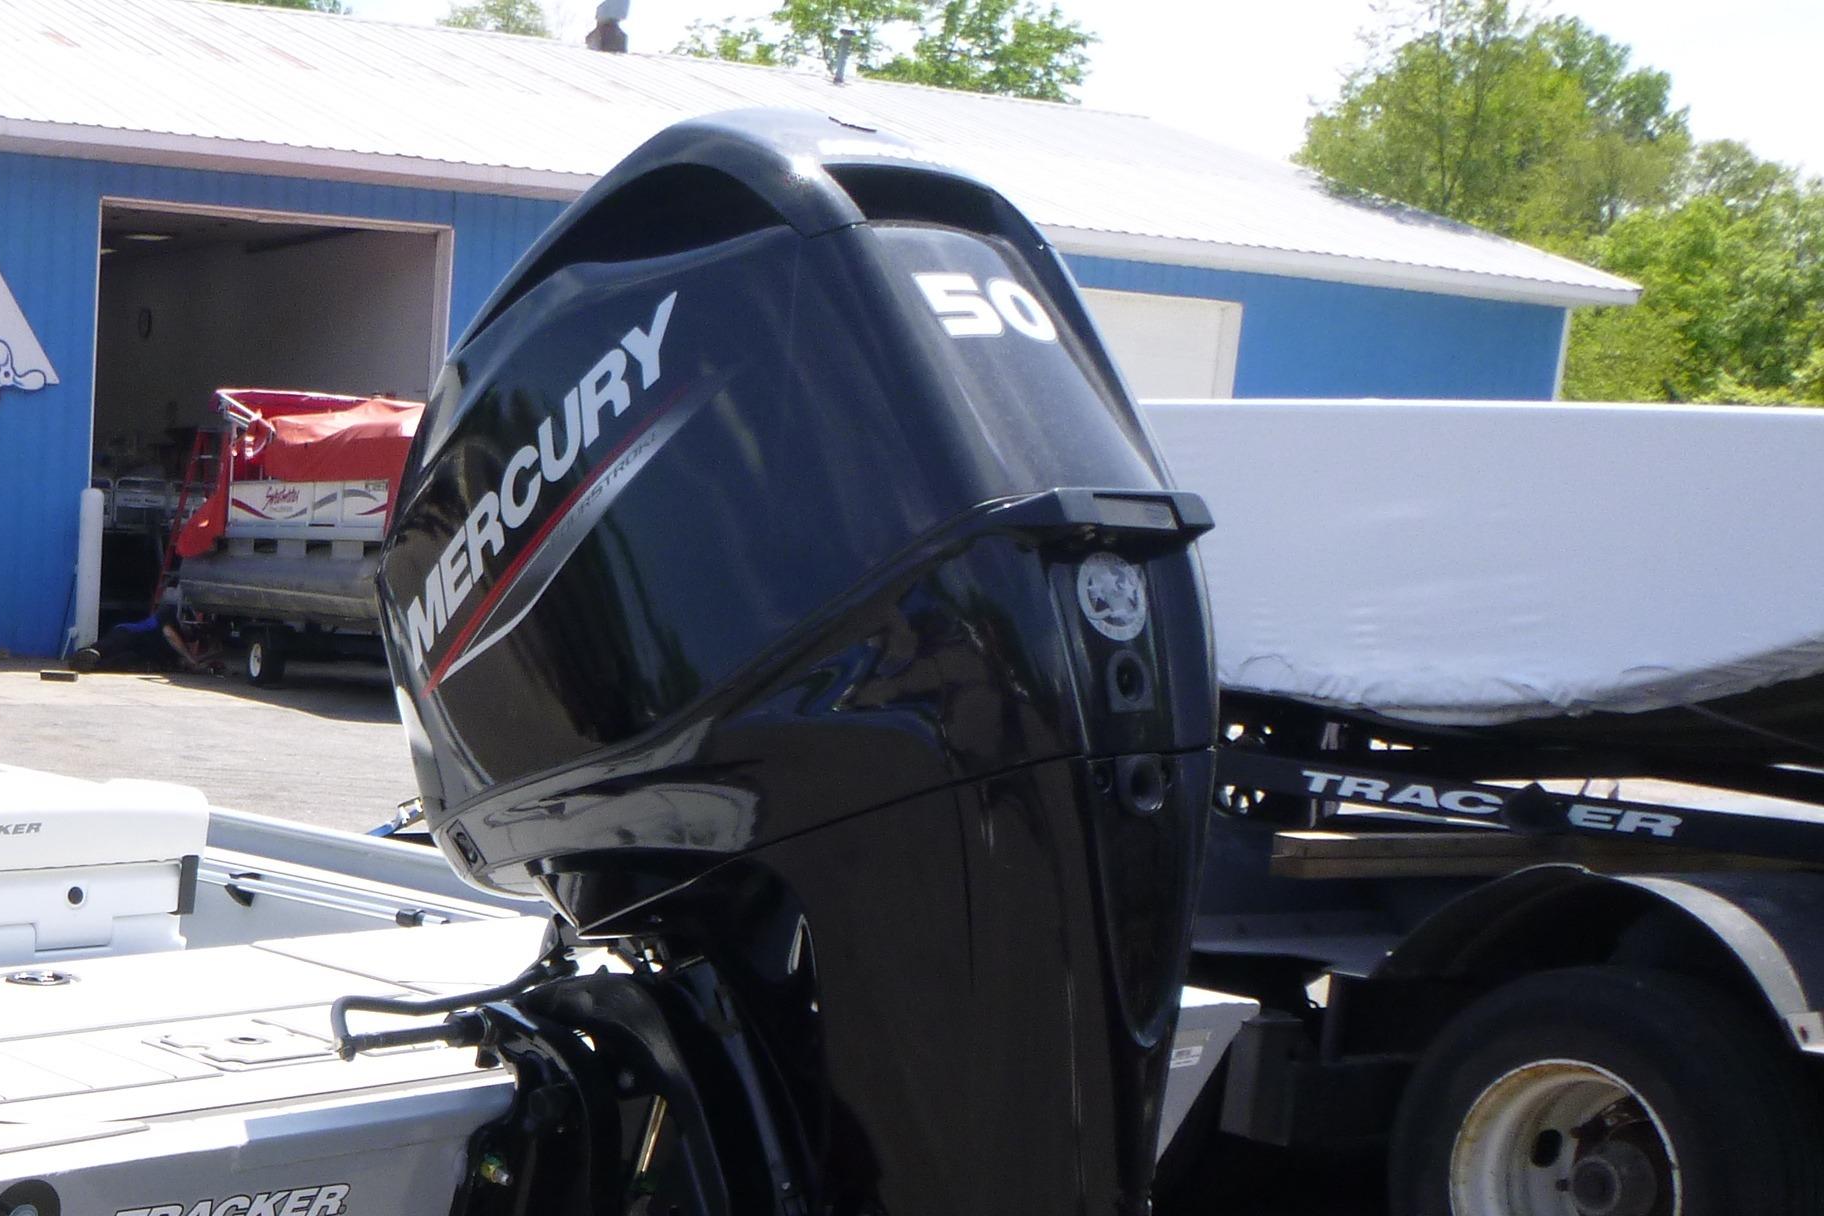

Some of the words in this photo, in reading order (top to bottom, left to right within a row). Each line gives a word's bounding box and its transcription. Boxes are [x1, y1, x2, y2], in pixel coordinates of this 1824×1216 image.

[911, 272, 1059, 344] 50
[407, 290, 678, 671] MERCURY
[1301, 769, 1683, 839] TRACER
